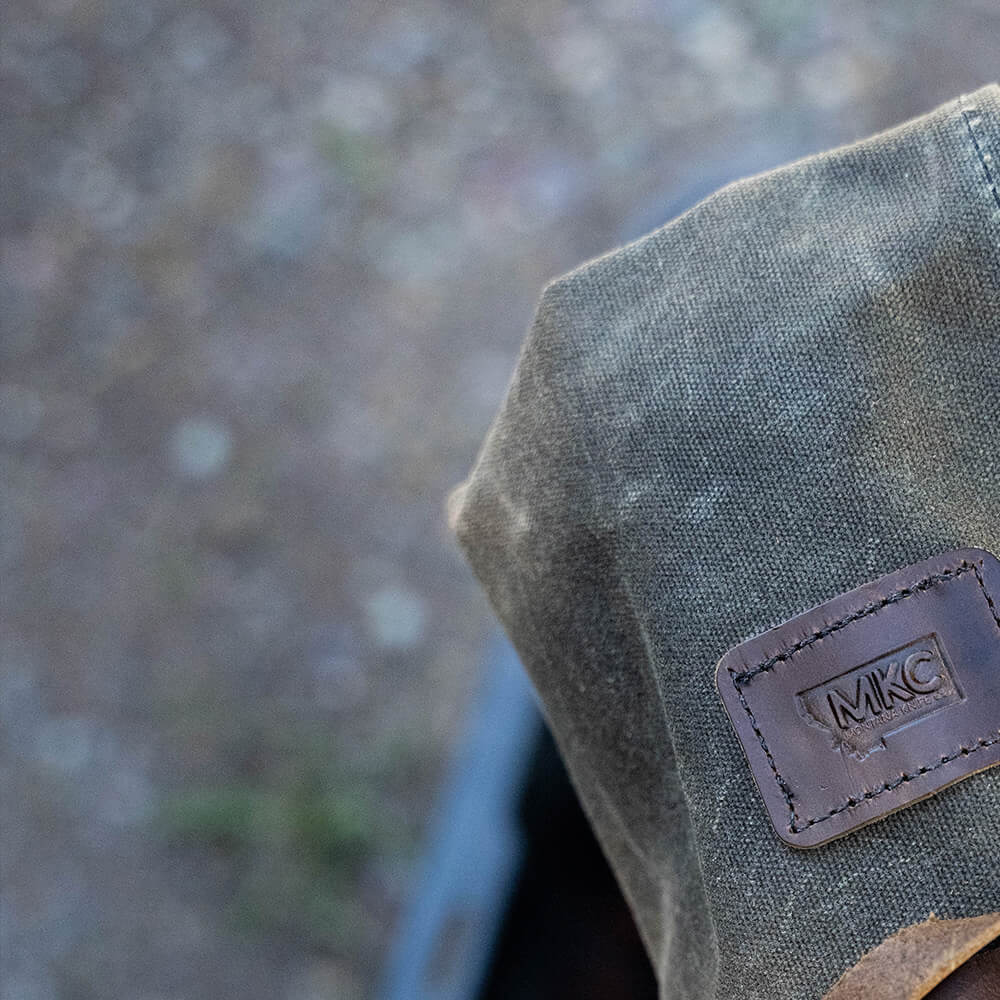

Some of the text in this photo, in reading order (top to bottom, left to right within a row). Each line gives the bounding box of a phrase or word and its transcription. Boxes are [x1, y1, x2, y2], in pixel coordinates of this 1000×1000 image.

[828, 650, 942, 729] MKC
[843, 711, 900, 739] MONTANA
[901, 695, 932, 714] KNIFE
